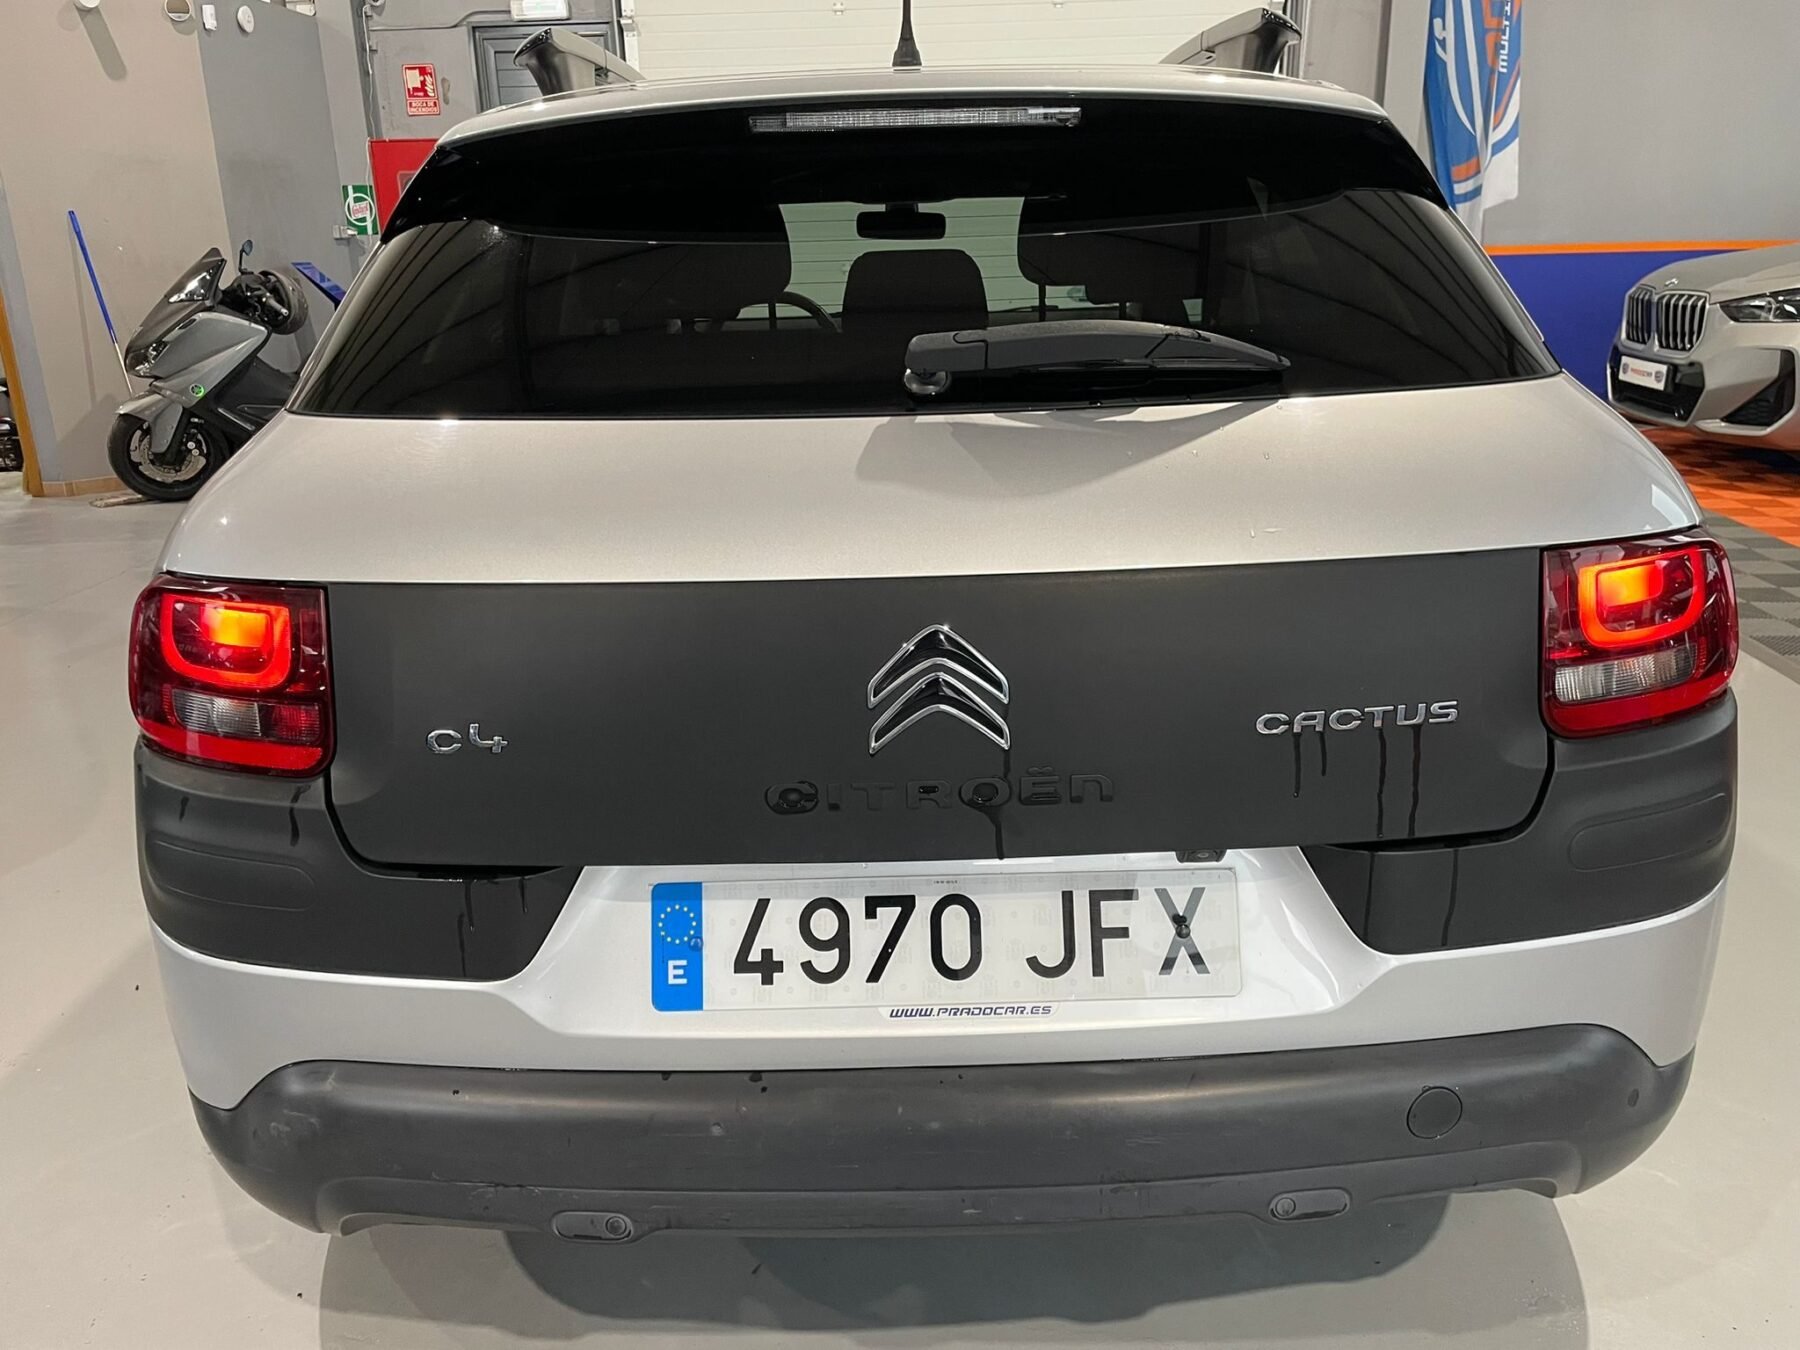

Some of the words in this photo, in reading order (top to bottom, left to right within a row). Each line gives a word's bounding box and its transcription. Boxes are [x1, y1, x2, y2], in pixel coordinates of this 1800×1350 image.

[1498, 0, 1511, 73] MULTI
[1255, 700, 1459, 736] CACTUS
[426, 723, 508, 754] C4
[733, 893, 982, 986] 4970
[1026, 886, 1212, 979] JFX
[667, 959, 688, 985] E
[889, 1005, 1052, 1018] WWW.PRADOCAR.ES
